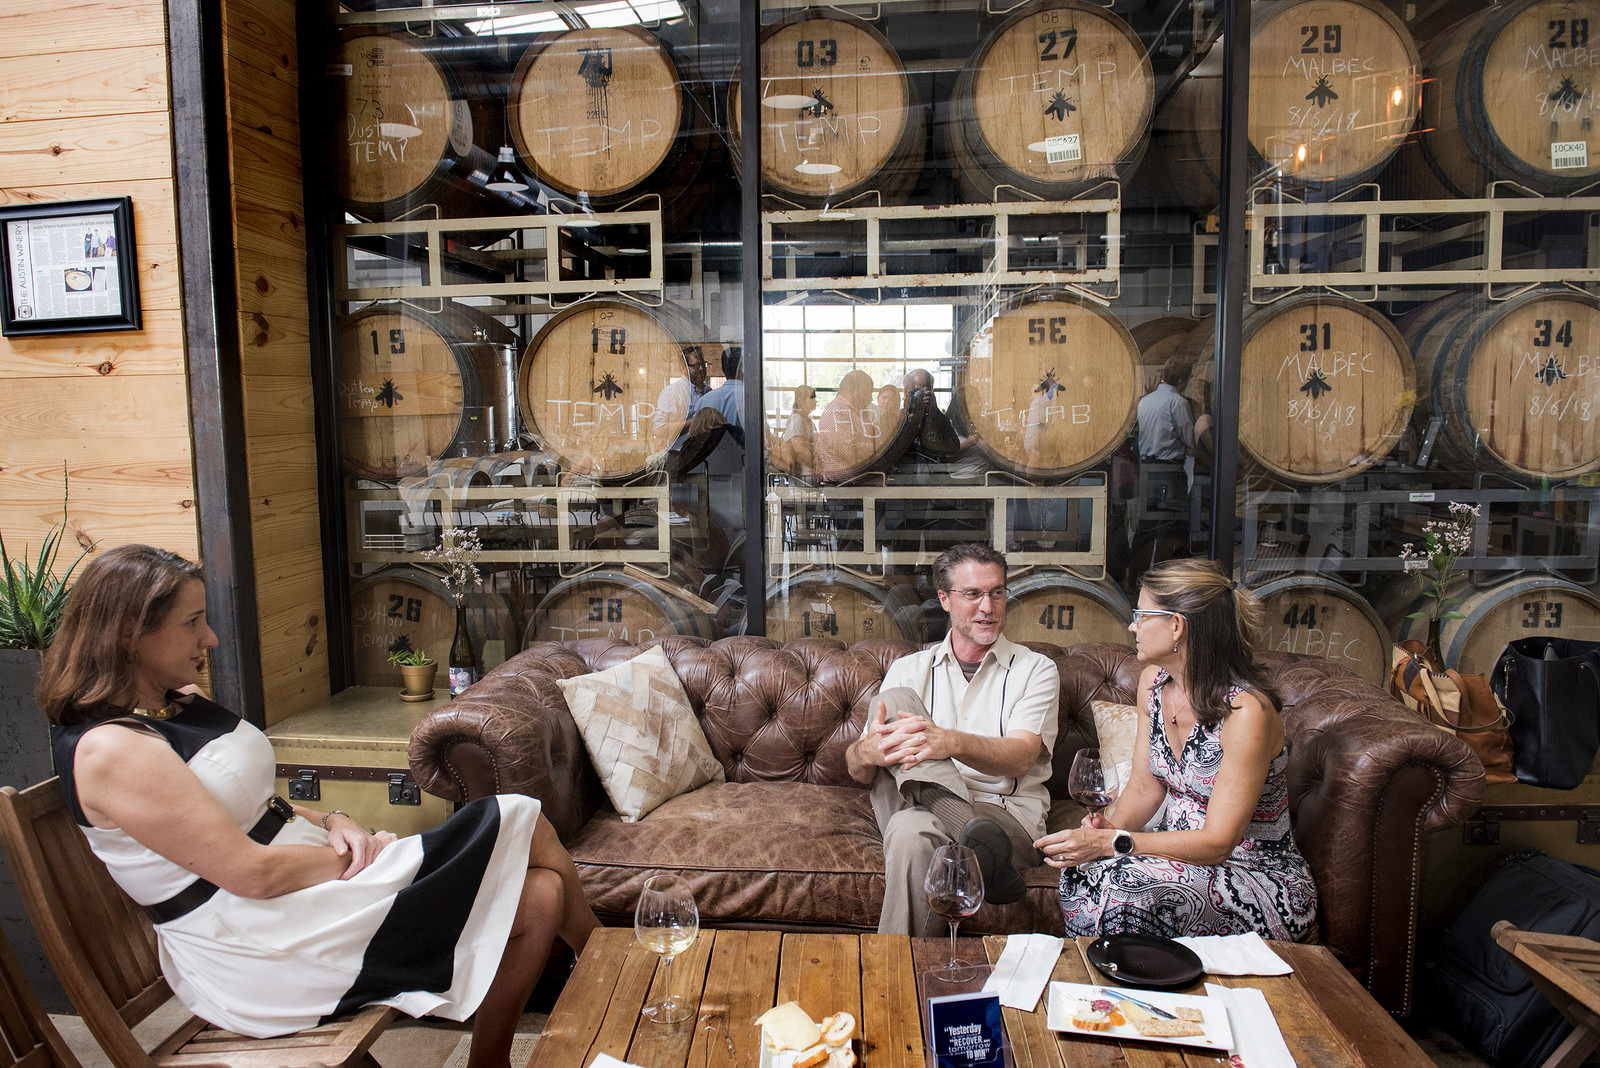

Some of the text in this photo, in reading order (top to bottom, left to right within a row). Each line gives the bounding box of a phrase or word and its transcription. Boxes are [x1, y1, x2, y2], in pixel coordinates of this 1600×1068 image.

[1039, 28, 1078, 61] 27
[1301, 25, 1341, 54] 29
[1549, 18, 1589, 48] 28
[797, 39, 837, 68] 03
[1282, 55, 1375, 80] MALBEC
[999, 61, 1117, 94] TEMP
[356, 98, 384, 120] 73
[535, 119, 661, 158] TEMP
[768, 116, 882, 153] TEMP
[1553, 143, 1585, 153] 10CK40
[349, 136, 408, 165] TEMP
[14, 224, 28, 304] THE AUSTIN WINERY
[370, 329, 405, 355] 19
[592, 328, 625, 354] 18
[1300, 322, 1331, 352] 31
[1533, 319, 1573, 347] 34
[1277, 352, 1374, 383] MALBEC
[546, 399, 656, 432] TEMP
[388, 594, 422, 622] 26
[588, 596, 622, 623] 38
[1038, 604, 1075, 630] 40
[1283, 603, 1317, 629] 44
[1522, 602, 1563, 628] 33
[1259, 626, 1361, 661] MALBEC
[949, 1043, 990, 1053] tomorrow
